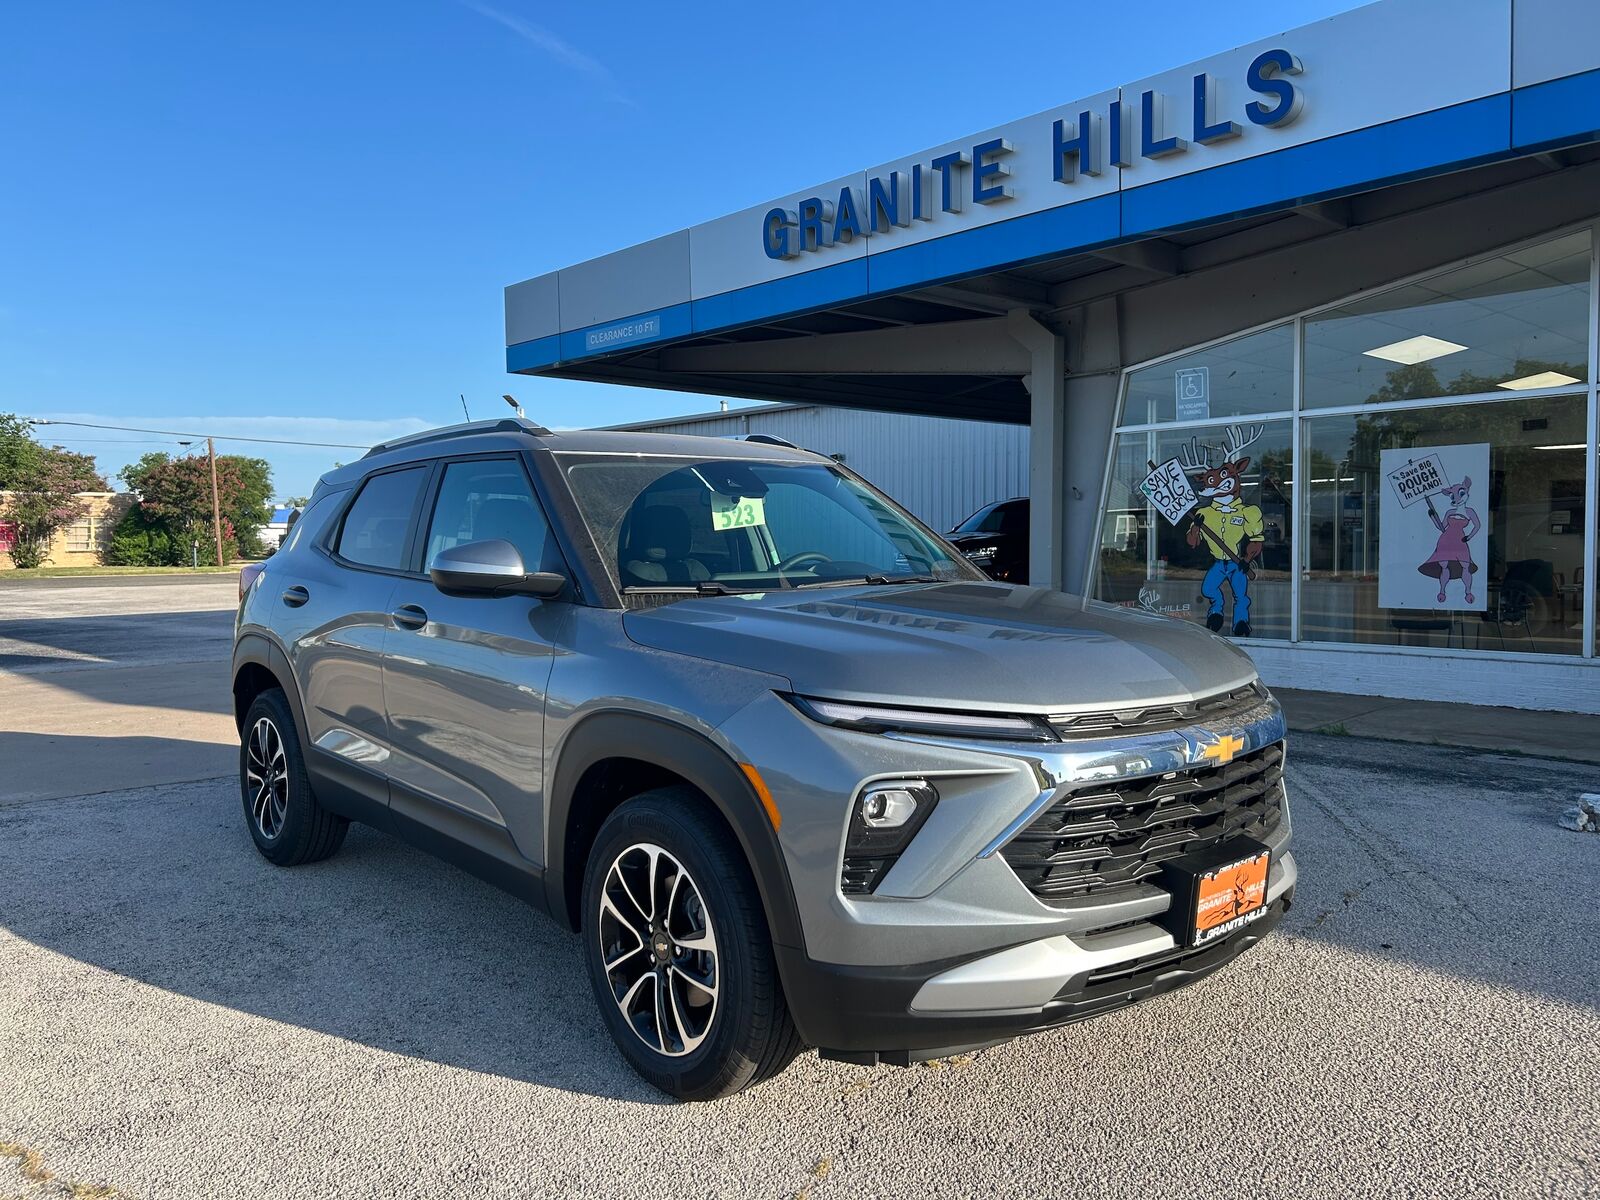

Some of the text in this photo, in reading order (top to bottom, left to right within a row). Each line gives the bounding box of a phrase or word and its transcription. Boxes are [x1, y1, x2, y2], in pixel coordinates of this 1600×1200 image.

[763, 49, 1302, 260] GRANITE HILLS
[590, 321, 654, 345] CLEARANCE 10 FT
[1147, 462, 1180, 492] SAVE
[1398, 467, 1438, 493] DOUGH
[1400, 460, 1432, 480] Save BIG
[1153, 479, 1185, 508] BIG
[1412, 478, 1442, 495] LLANO!
[721, 504, 755, 527] 523
[1165, 489, 1196, 521] BUCKS
[1159, 603, 1191, 613] HILLS
[1198, 894, 1232, 912] GRANITE
[1246, 881, 1265, 892] HILLS
[1206, 906, 1268, 938] GRANITE HILLS
